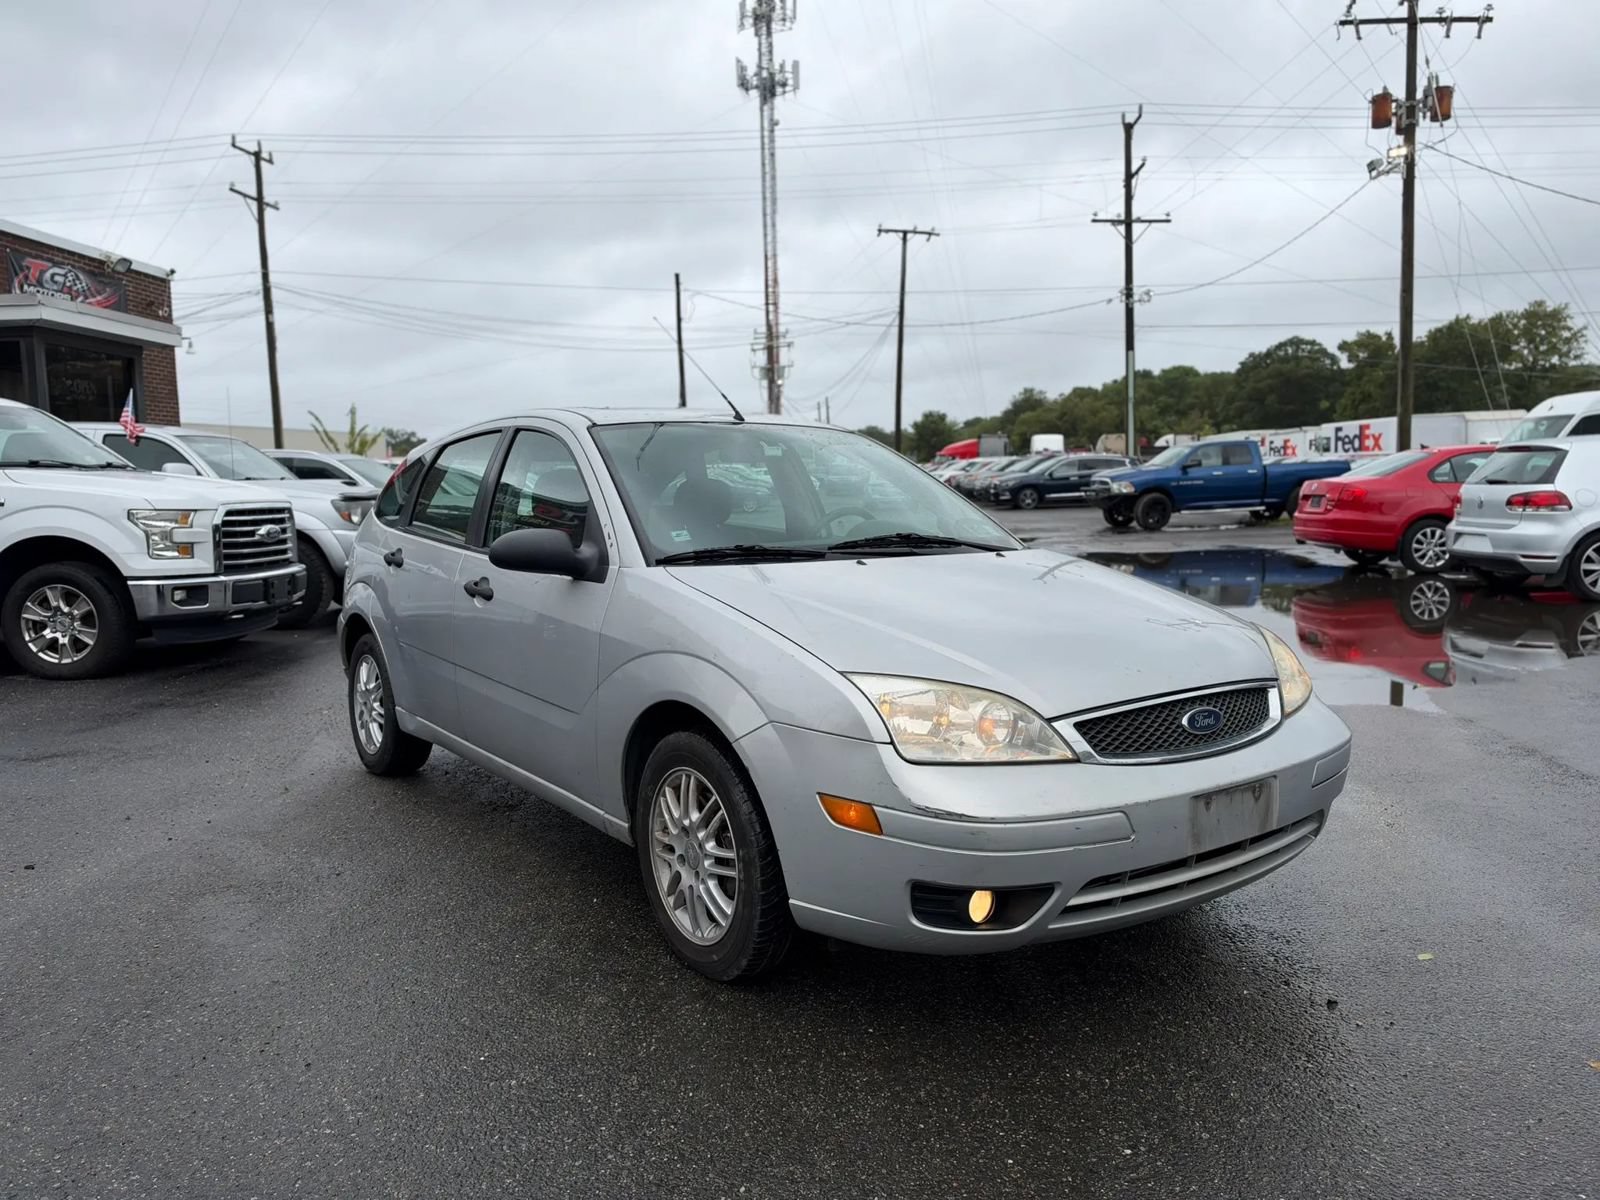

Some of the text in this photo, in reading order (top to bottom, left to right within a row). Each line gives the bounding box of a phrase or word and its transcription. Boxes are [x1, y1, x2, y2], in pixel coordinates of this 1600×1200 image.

[23, 285, 72, 302] MOTORS
[1334, 423, 1383, 453] FedEx
[1269, 438, 1297, 457] FedEx
[1194, 712, 1216, 728] Ford
